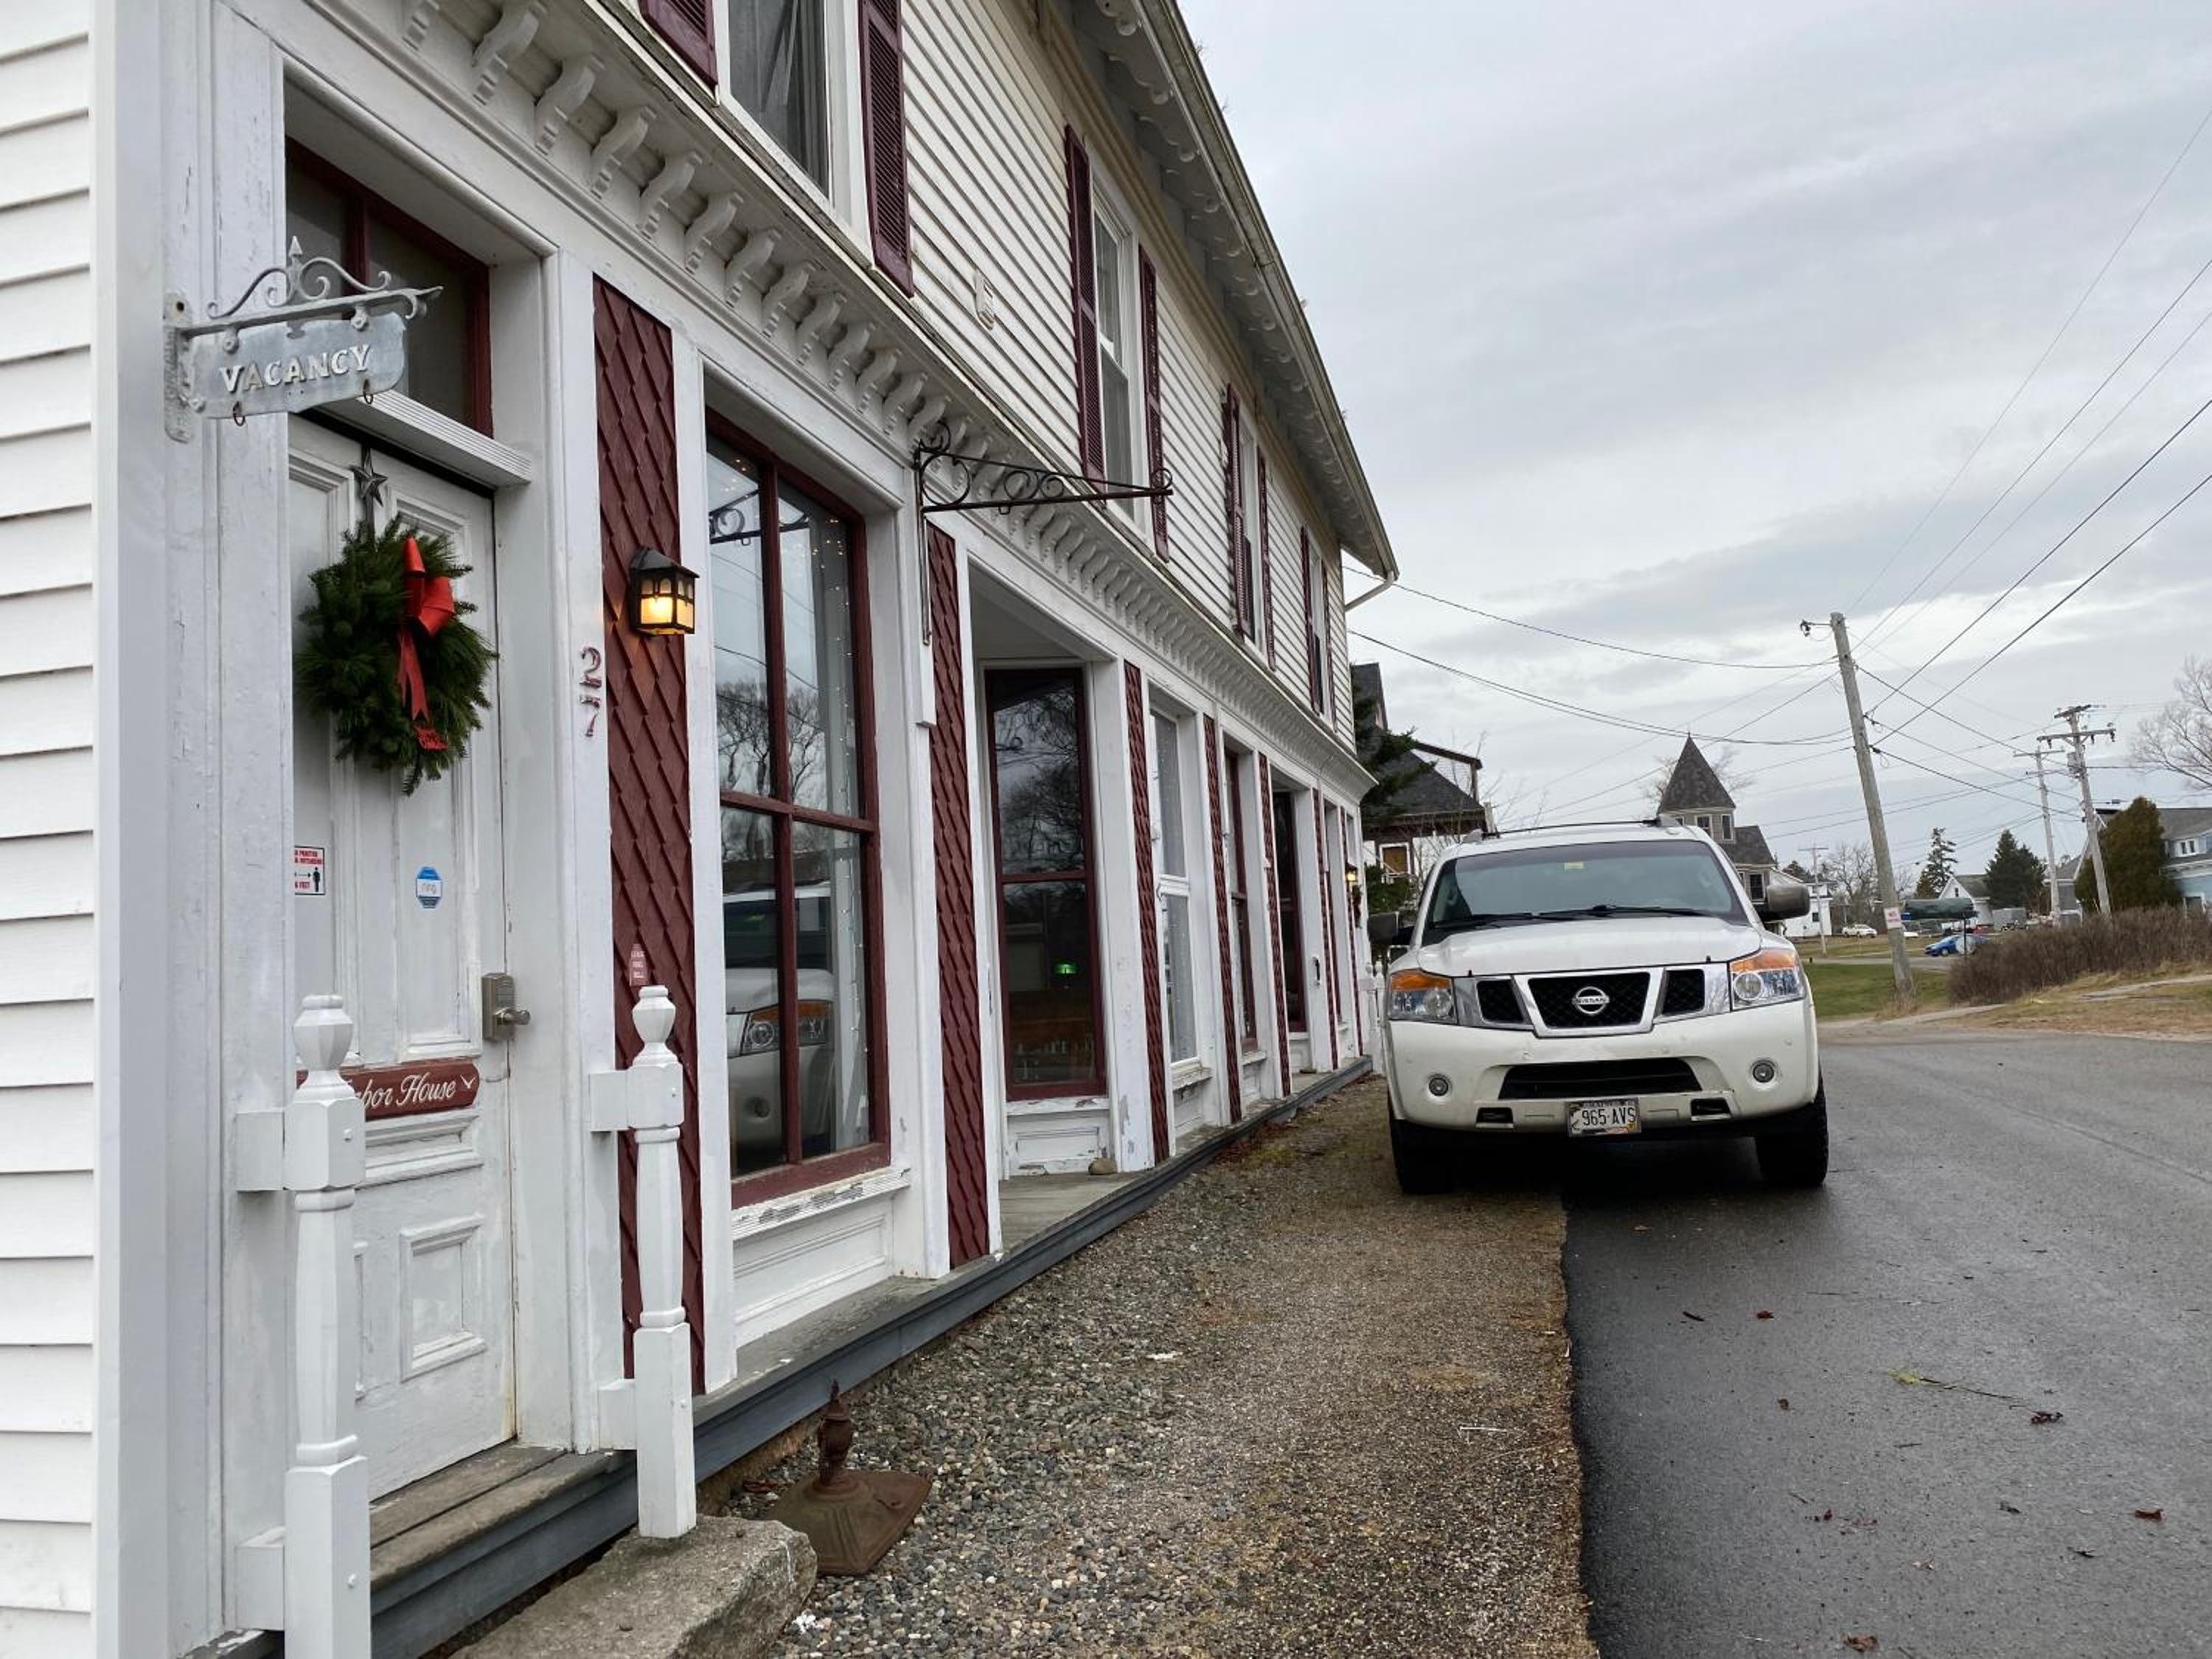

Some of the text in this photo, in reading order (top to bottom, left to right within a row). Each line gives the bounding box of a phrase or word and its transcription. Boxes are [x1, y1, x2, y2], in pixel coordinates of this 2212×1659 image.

[220, 344, 372, 393] VACANCY
[579, 647, 602, 737] 27
[355, 1072, 456, 1109] bor House
[1582, 1107, 1636, 1126] 965 AVS
